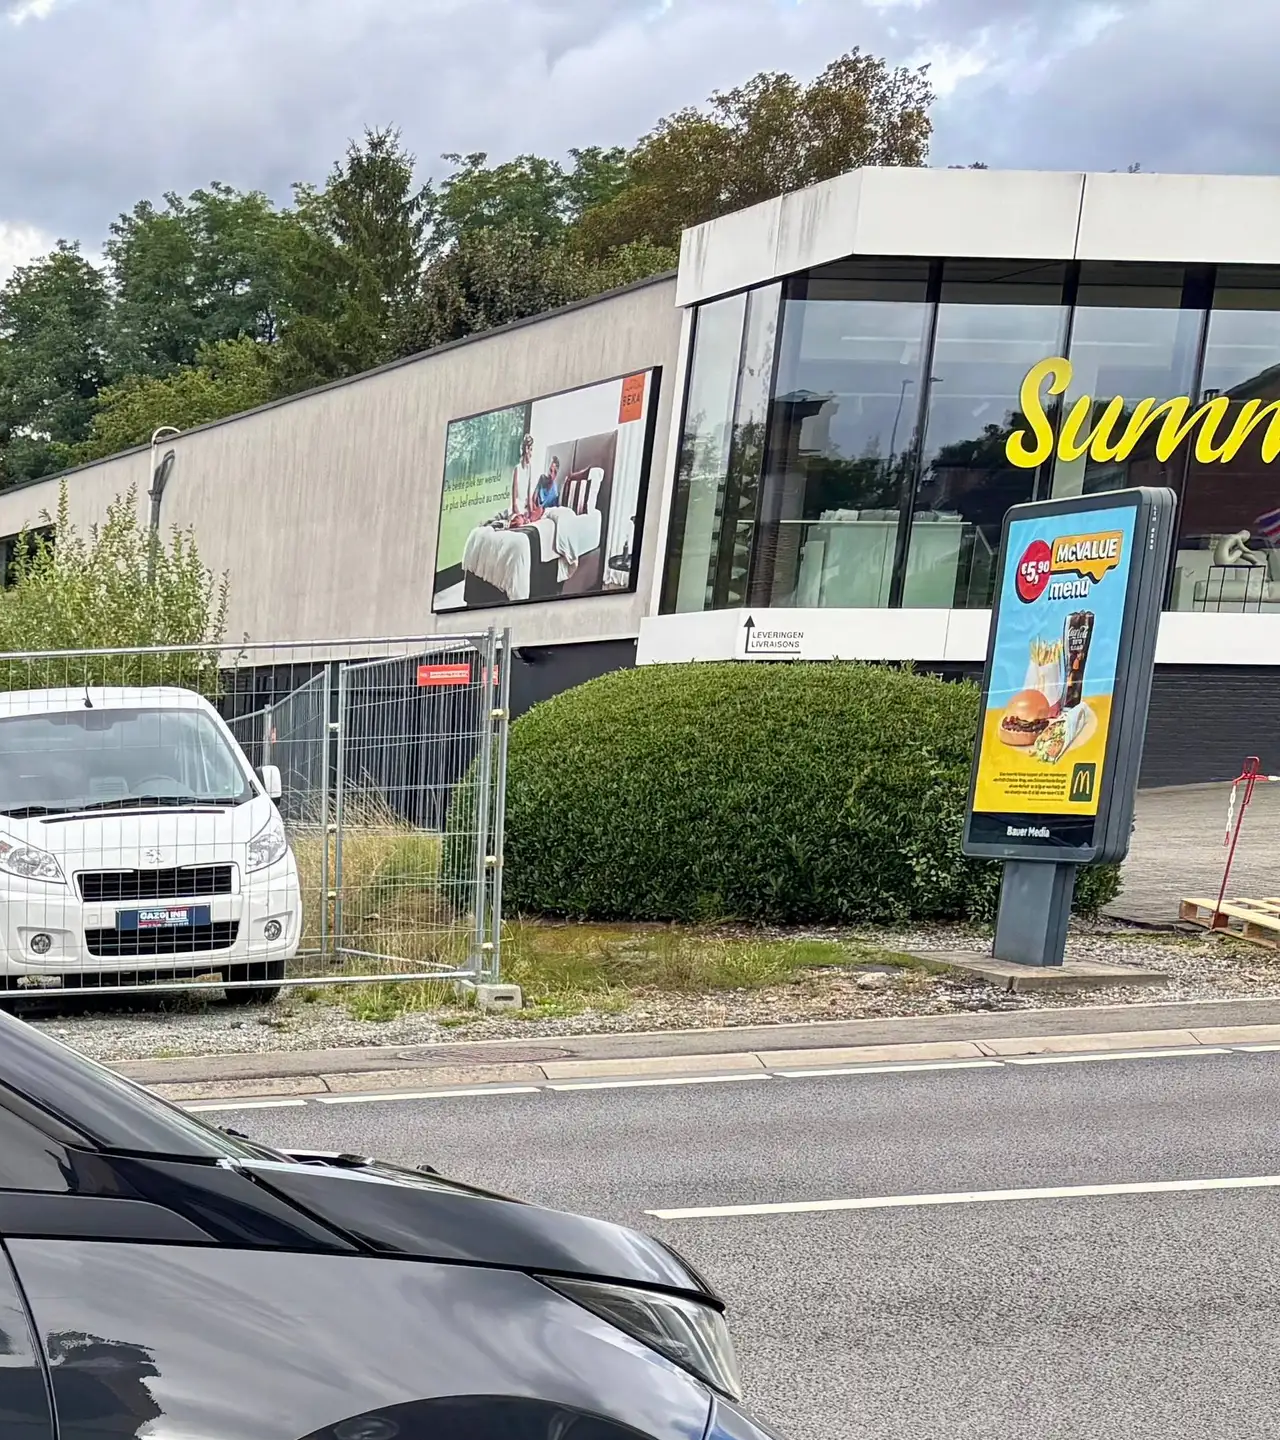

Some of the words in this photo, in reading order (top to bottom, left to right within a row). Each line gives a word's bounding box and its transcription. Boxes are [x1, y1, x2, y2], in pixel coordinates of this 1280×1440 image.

[1055, 538, 1119, 564] McVALUE
[1048, 579, 1090, 601] menu
[752, 631, 804, 639] LEVERINGEN
[751, 640, 800, 648] LIVRAISONS
